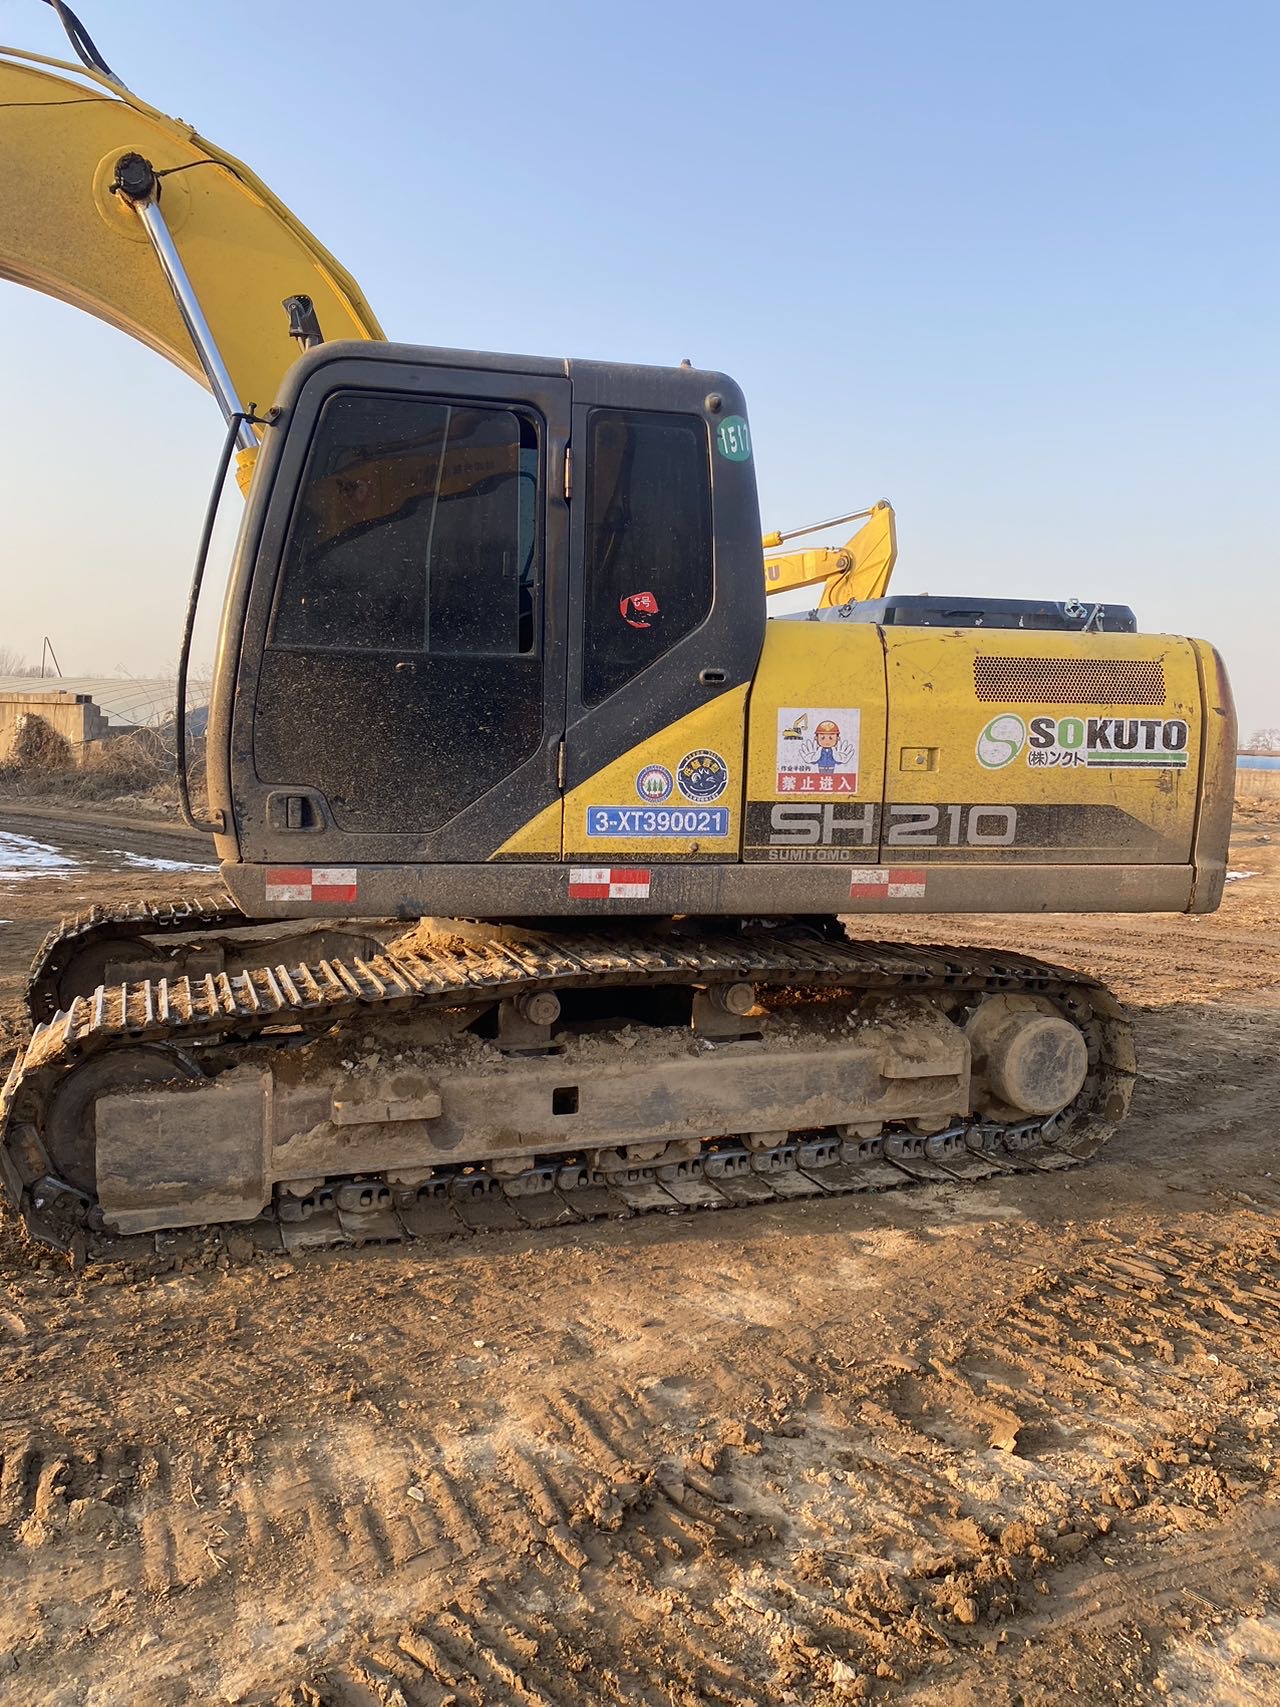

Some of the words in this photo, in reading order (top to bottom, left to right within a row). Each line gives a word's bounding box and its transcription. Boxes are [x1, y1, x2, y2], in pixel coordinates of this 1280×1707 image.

[1029, 718, 1187, 750] SOKUTO
[782, 775, 852, 790] 禁止进入
[595, 811, 720, 832] 3-XT390021
[769, 849, 850, 861] SUMITOMO
